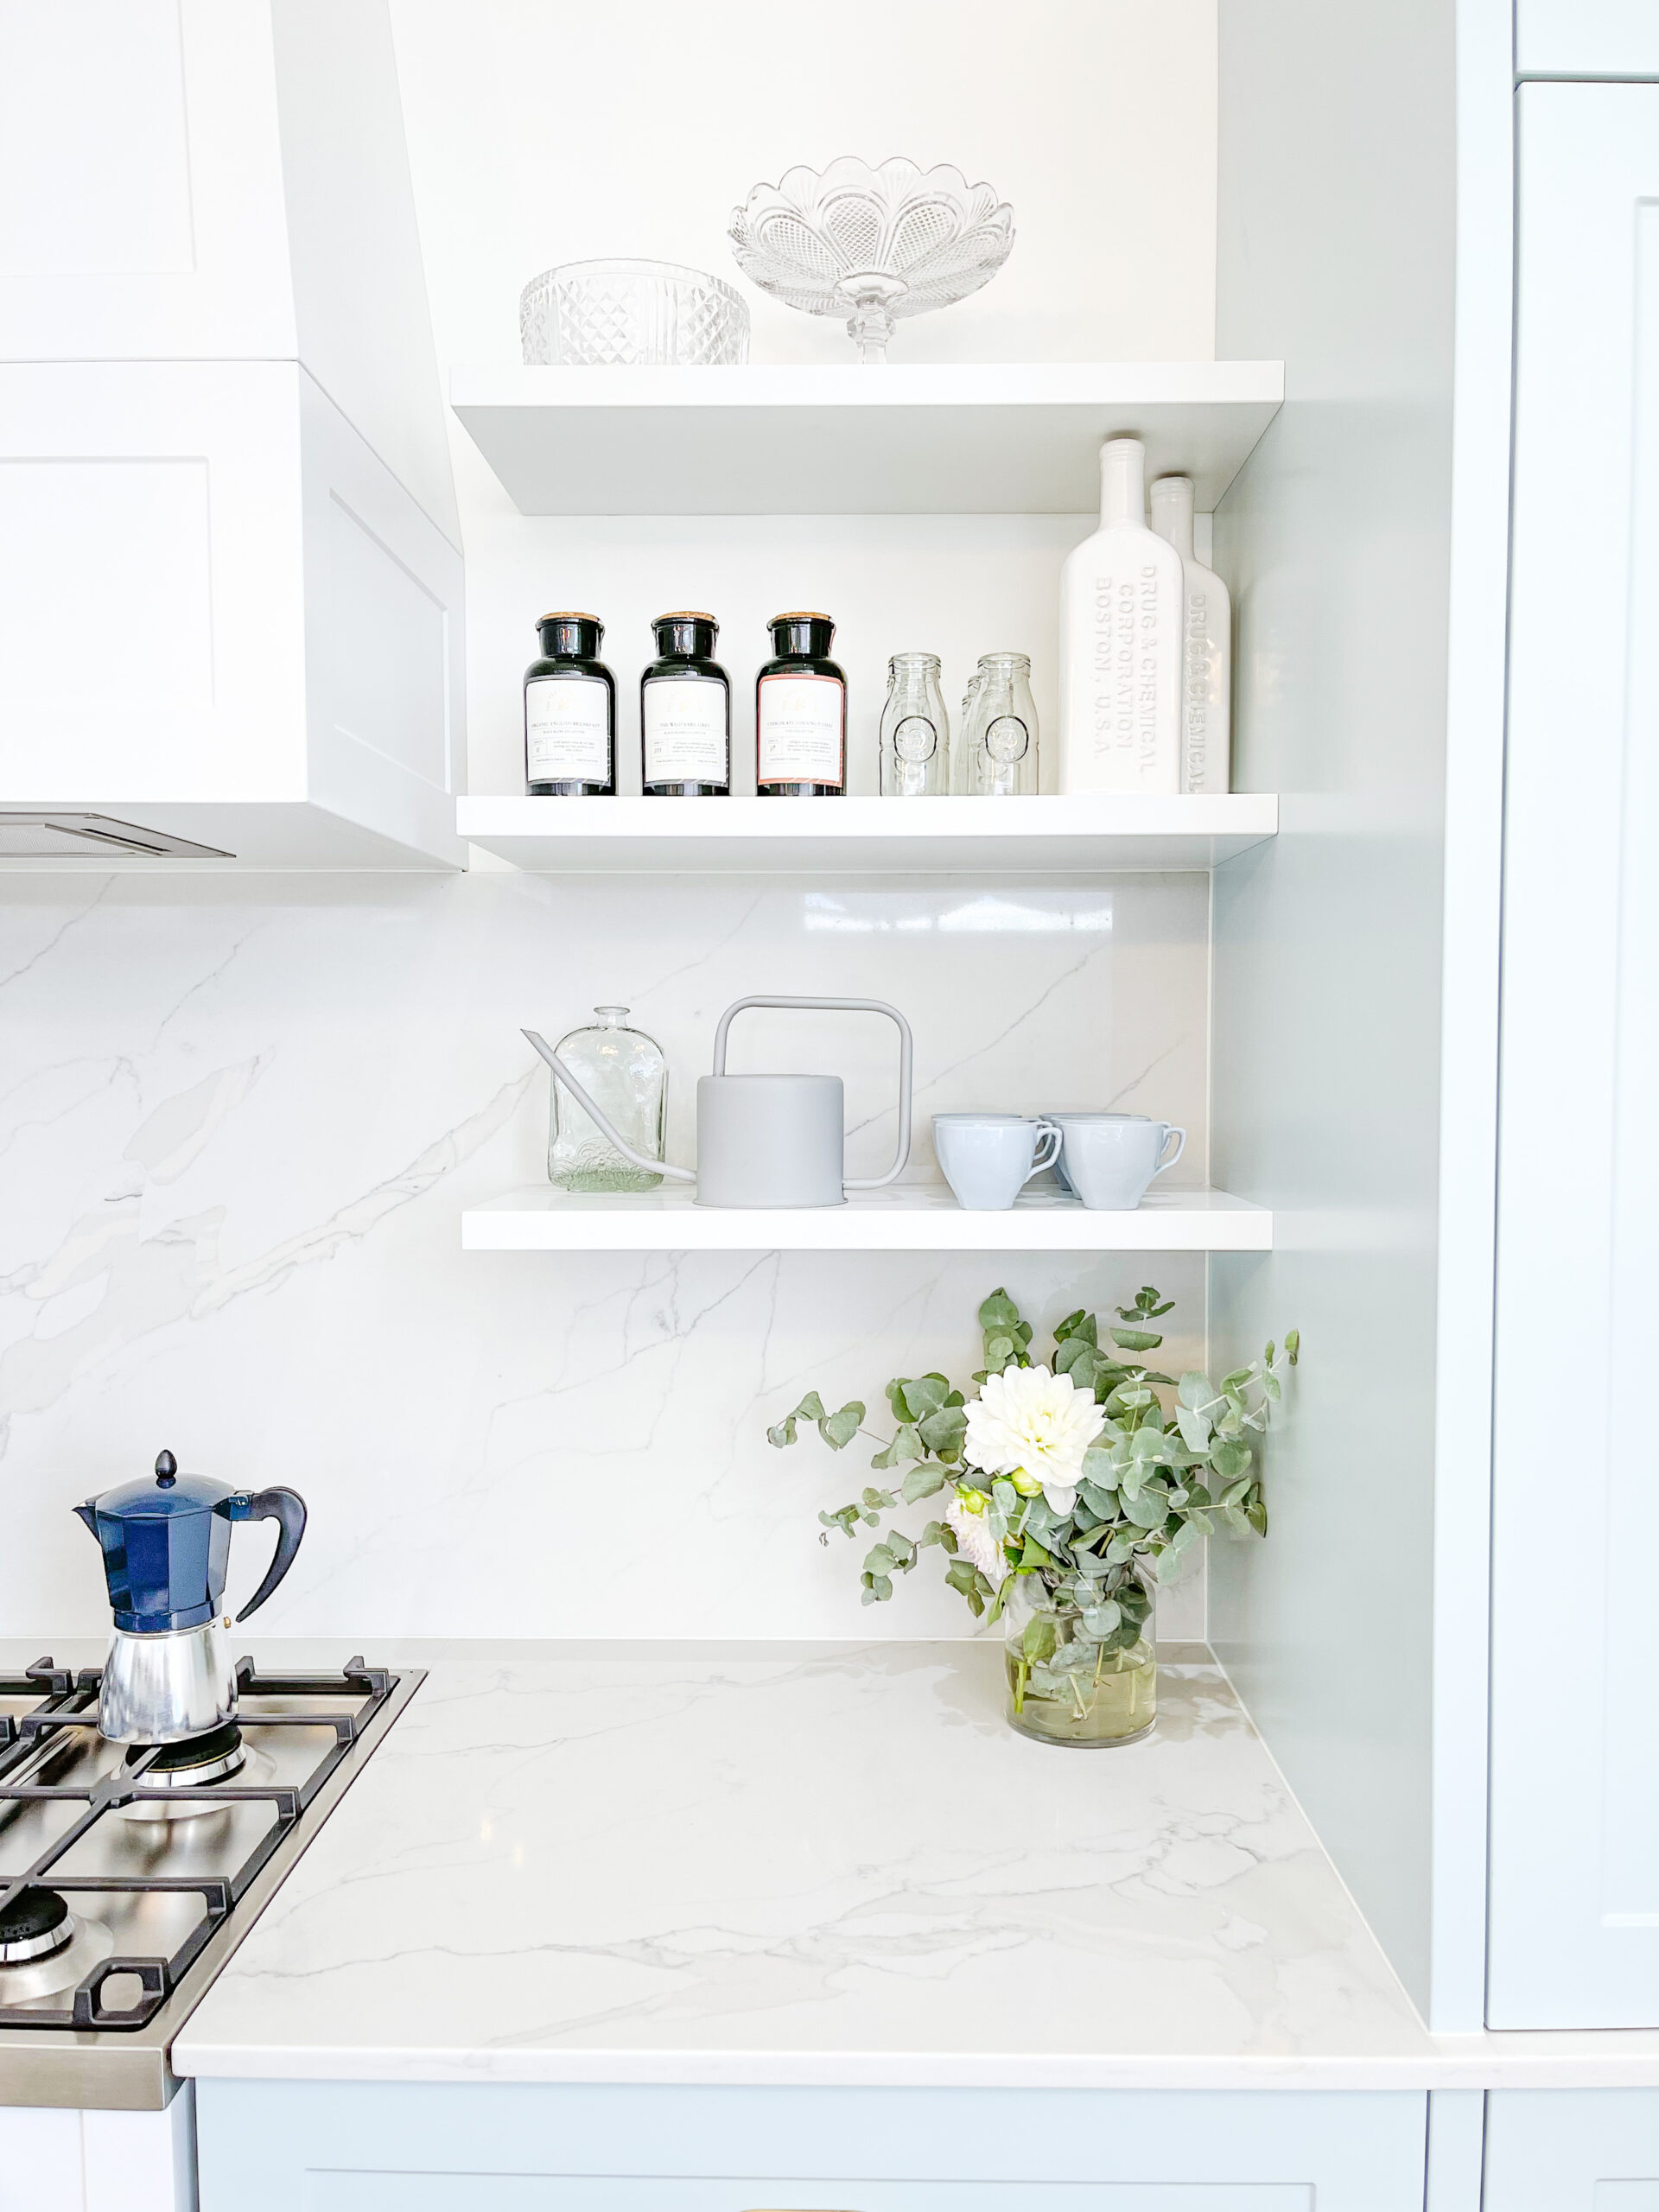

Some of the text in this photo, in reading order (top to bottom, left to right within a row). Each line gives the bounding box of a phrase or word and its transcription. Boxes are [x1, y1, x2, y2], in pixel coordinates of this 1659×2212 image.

[1117, 583, 1134, 749] CORPORATION
[1138, 564, 1157, 774] DRUG & CHEMICAL
[1188, 594, 1207, 794] DRUG & CHEMICAL
